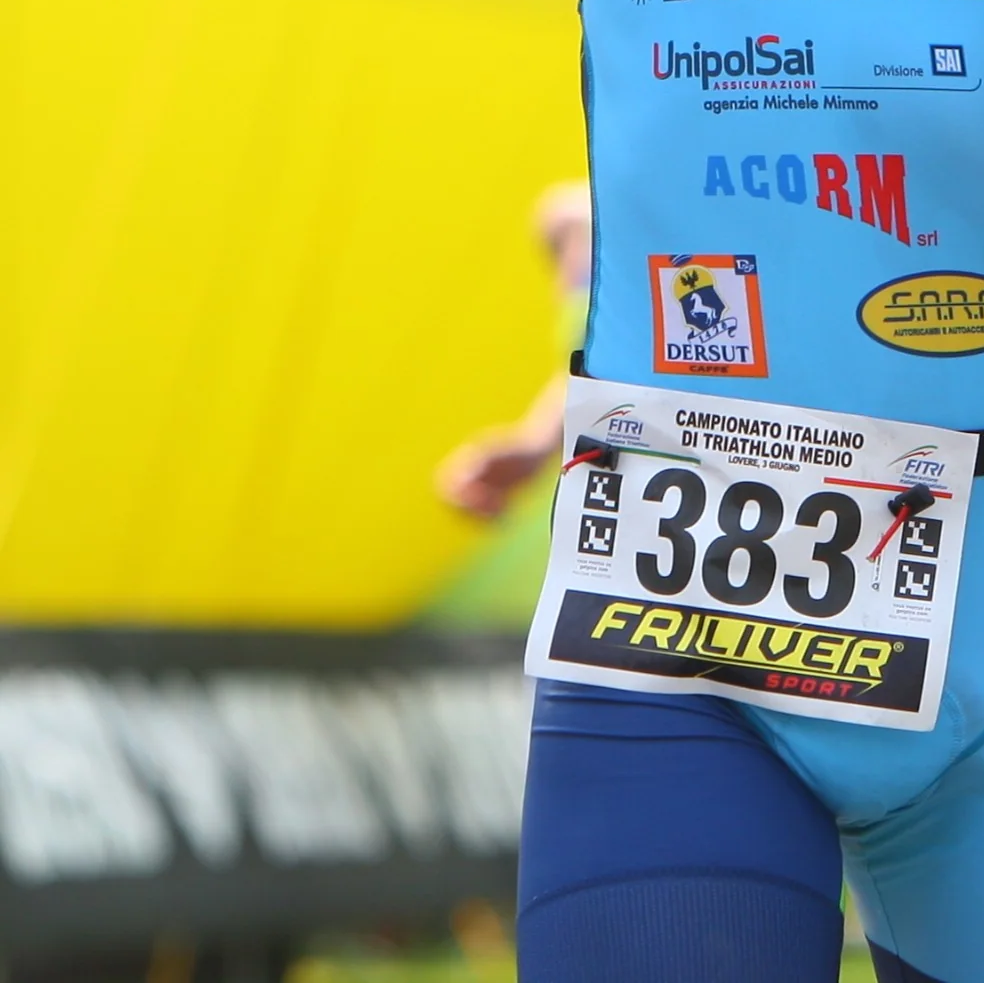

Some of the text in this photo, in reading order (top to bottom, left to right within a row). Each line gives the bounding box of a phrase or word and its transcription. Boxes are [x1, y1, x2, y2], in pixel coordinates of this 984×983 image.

[653, 34, 815, 91] UnipolSai
[873, 47, 962, 78] Divisione SAI
[713, 80, 817, 91] ASSICURAZIONI
[703, 94, 879, 113] agenzia Michele Mimmo
[917, 230, 938, 246] srl
[667, 343, 750, 363] DERSUT
[608, 418, 644, 435] FITRI
[675, 409, 865, 450] CAMPIONATO ITALIANO
[681, 430, 853, 468] DI TRIATHLON MEDIO
[727, 454, 801, 473] LOVERE, 3 GIUGNO
[904, 459, 946, 477] FITRI
[635, 468, 862, 619] 383
[590, 601, 893, 678] FRILIVER
[765, 672, 853, 697] SPORT
